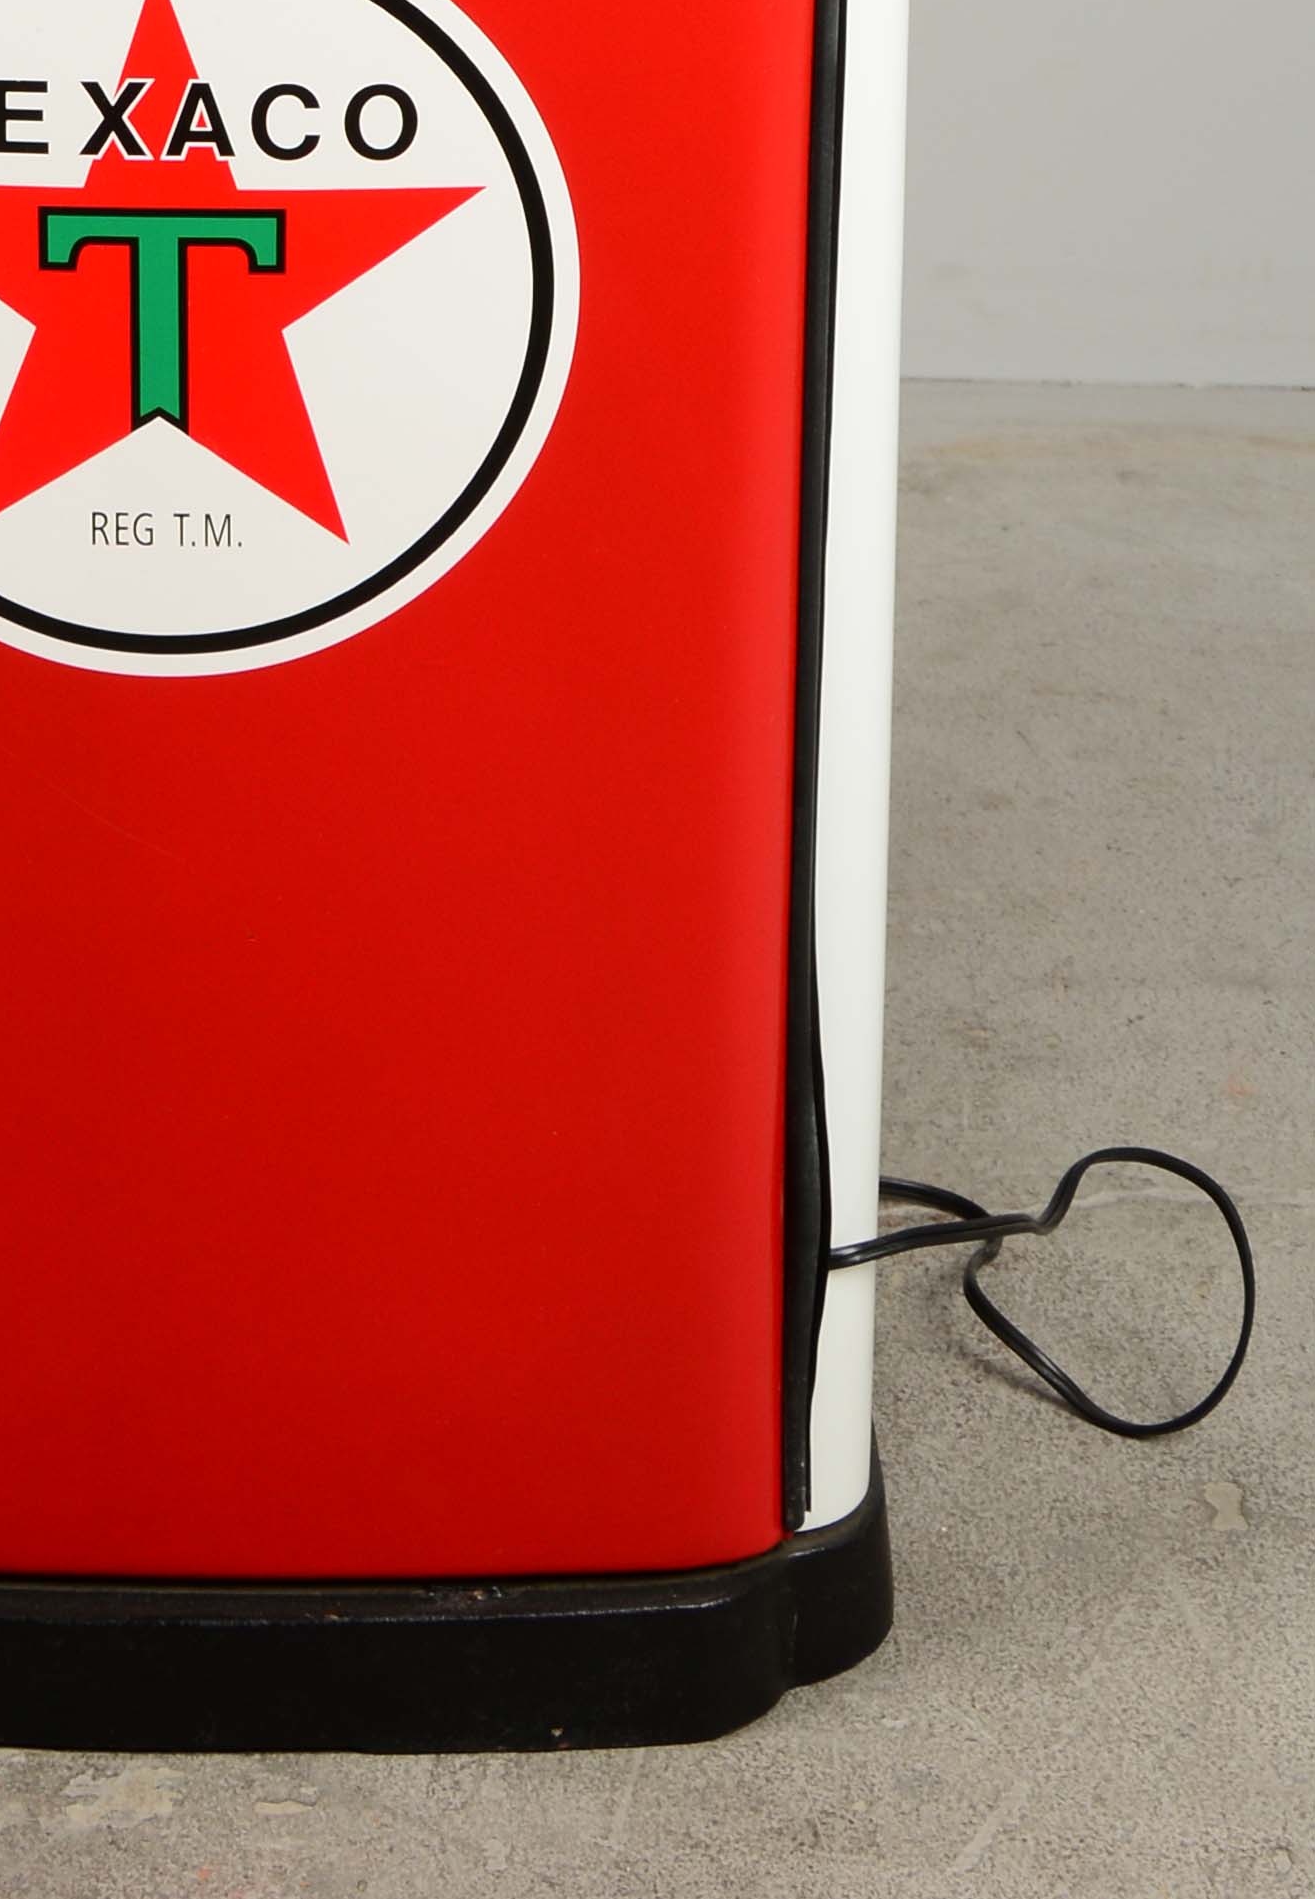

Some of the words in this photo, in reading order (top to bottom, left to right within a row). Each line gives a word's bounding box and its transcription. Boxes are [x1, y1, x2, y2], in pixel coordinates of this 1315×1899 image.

[38, 206, 286, 434] T
[90, 511, 155, 548] REG
[174, 511, 242, 548] T.M.
